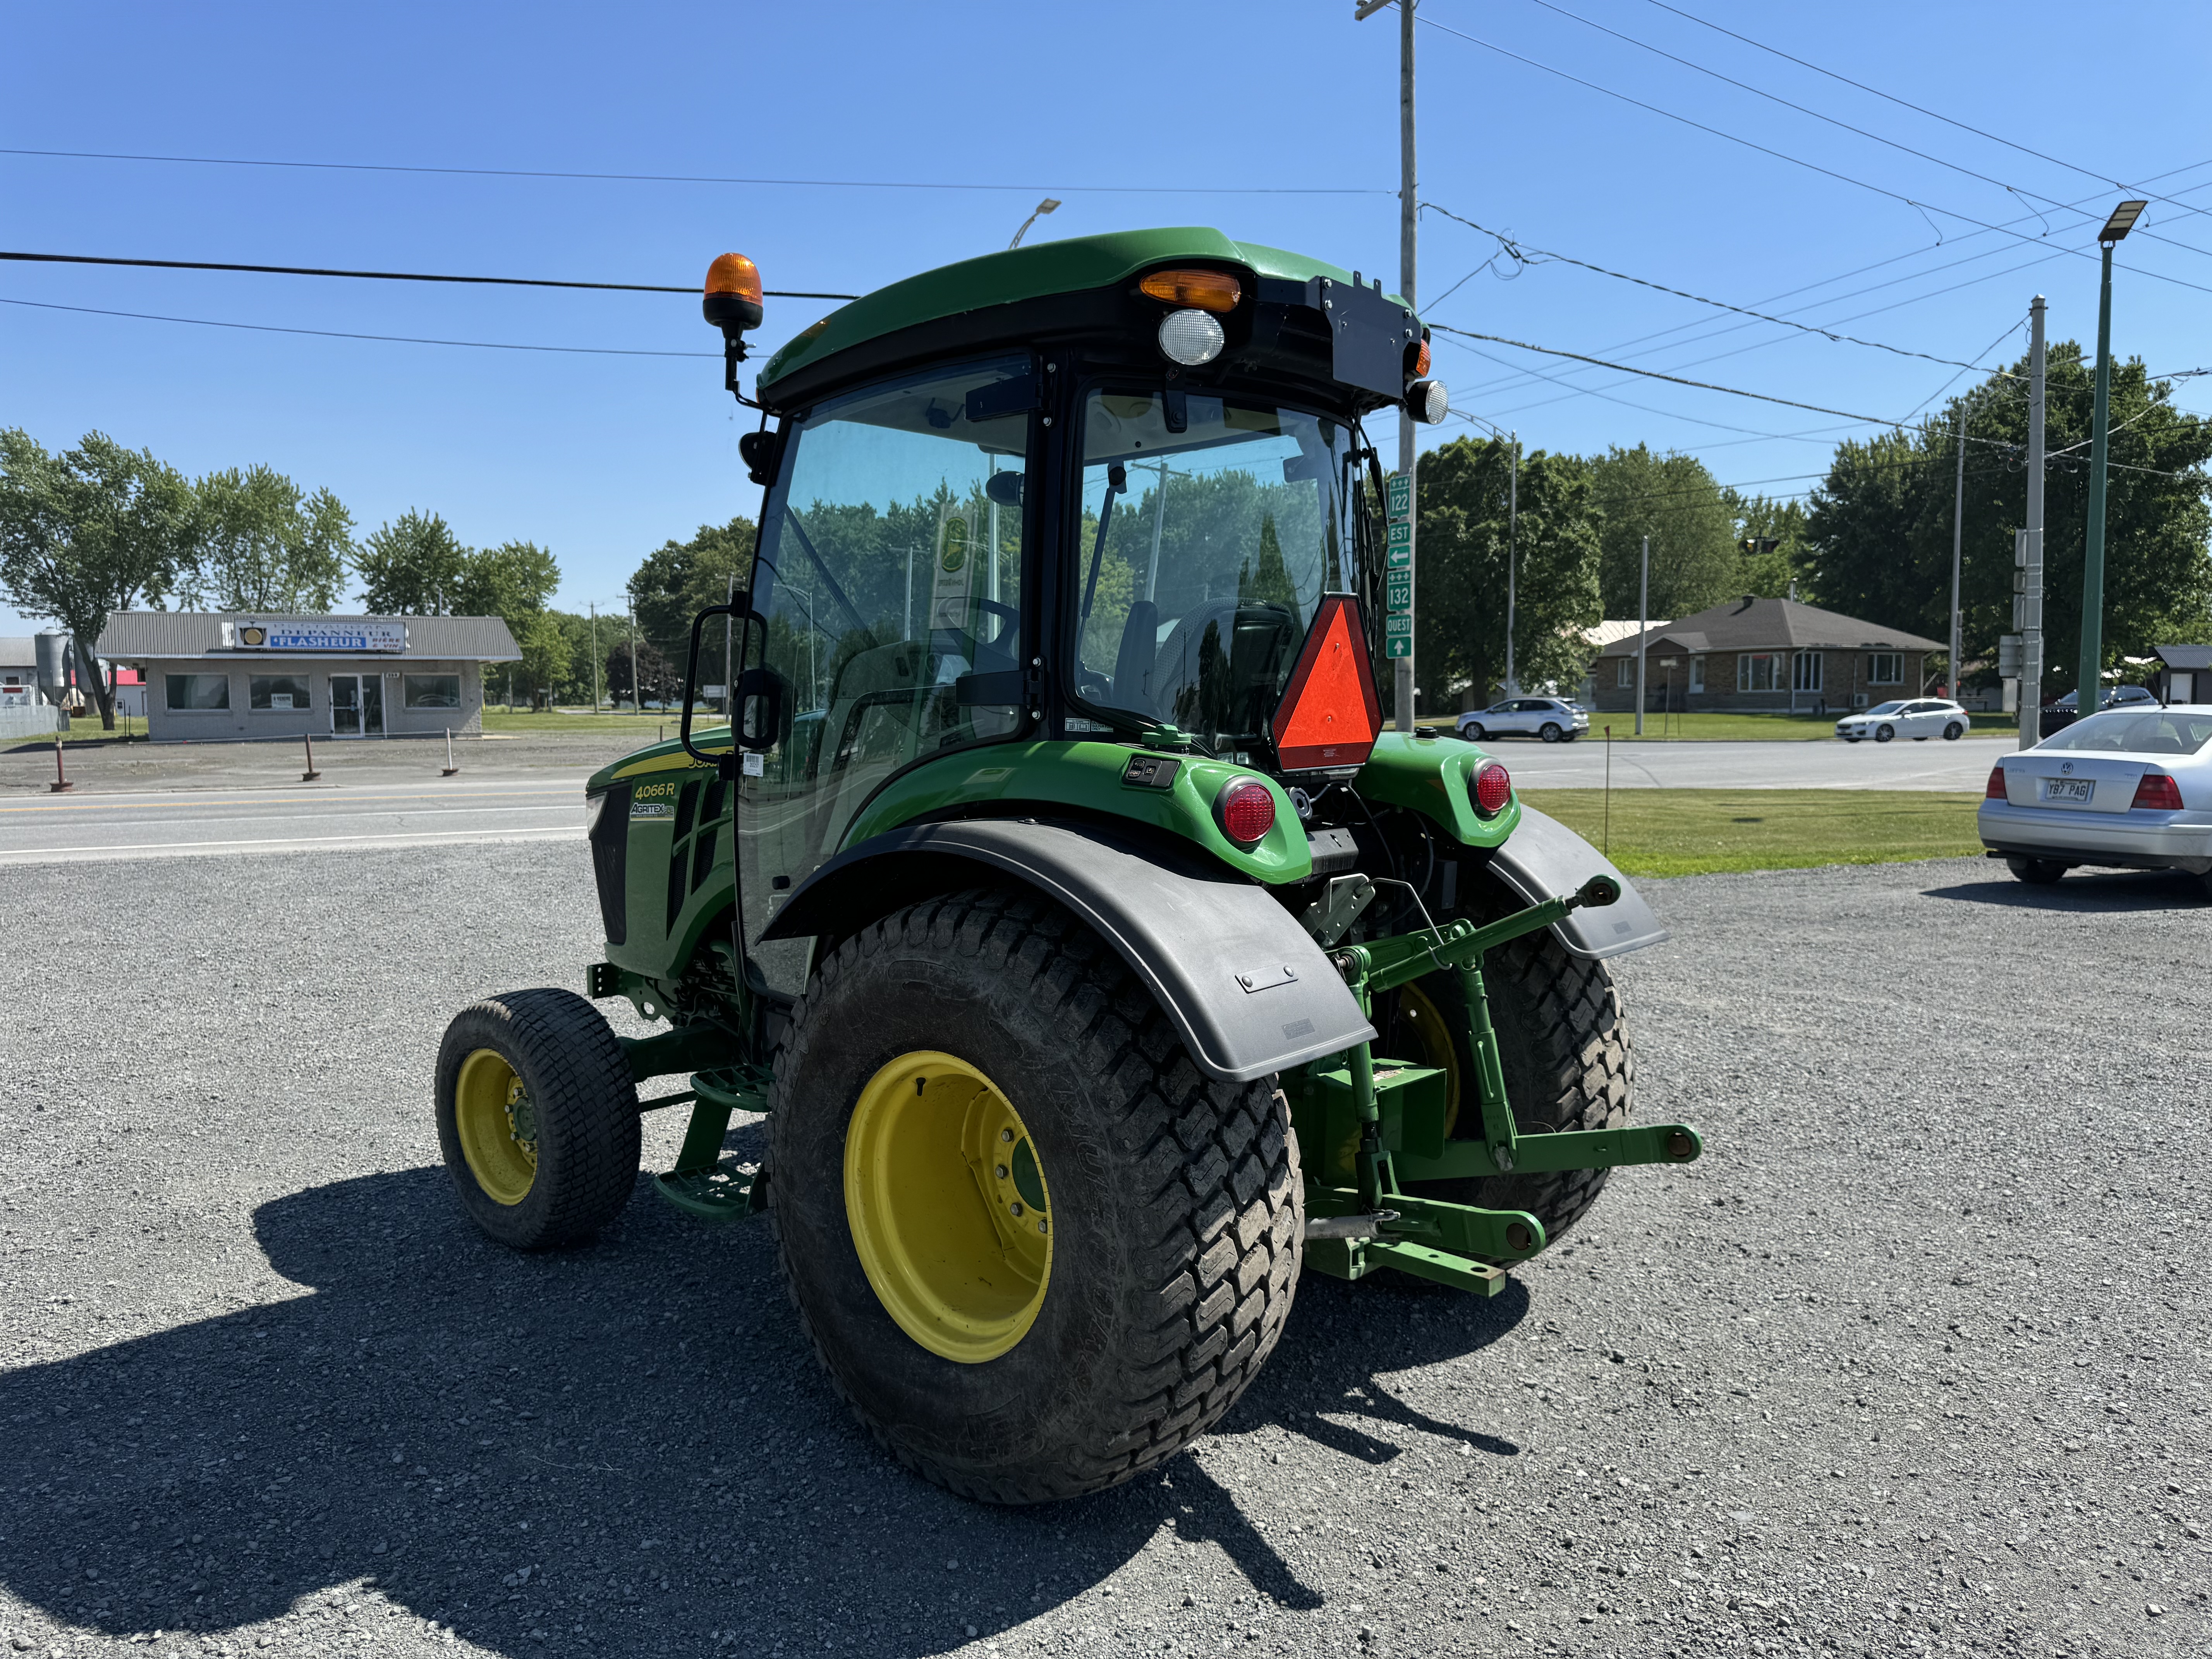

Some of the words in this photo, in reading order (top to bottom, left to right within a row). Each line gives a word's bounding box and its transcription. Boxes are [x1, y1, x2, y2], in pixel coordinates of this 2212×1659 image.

[1392, 494, 1408, 512] 122
[1391, 526, 1408, 541] EST
[1390, 587, 1408, 605] 132
[1388, 618, 1410, 632] OUEST
